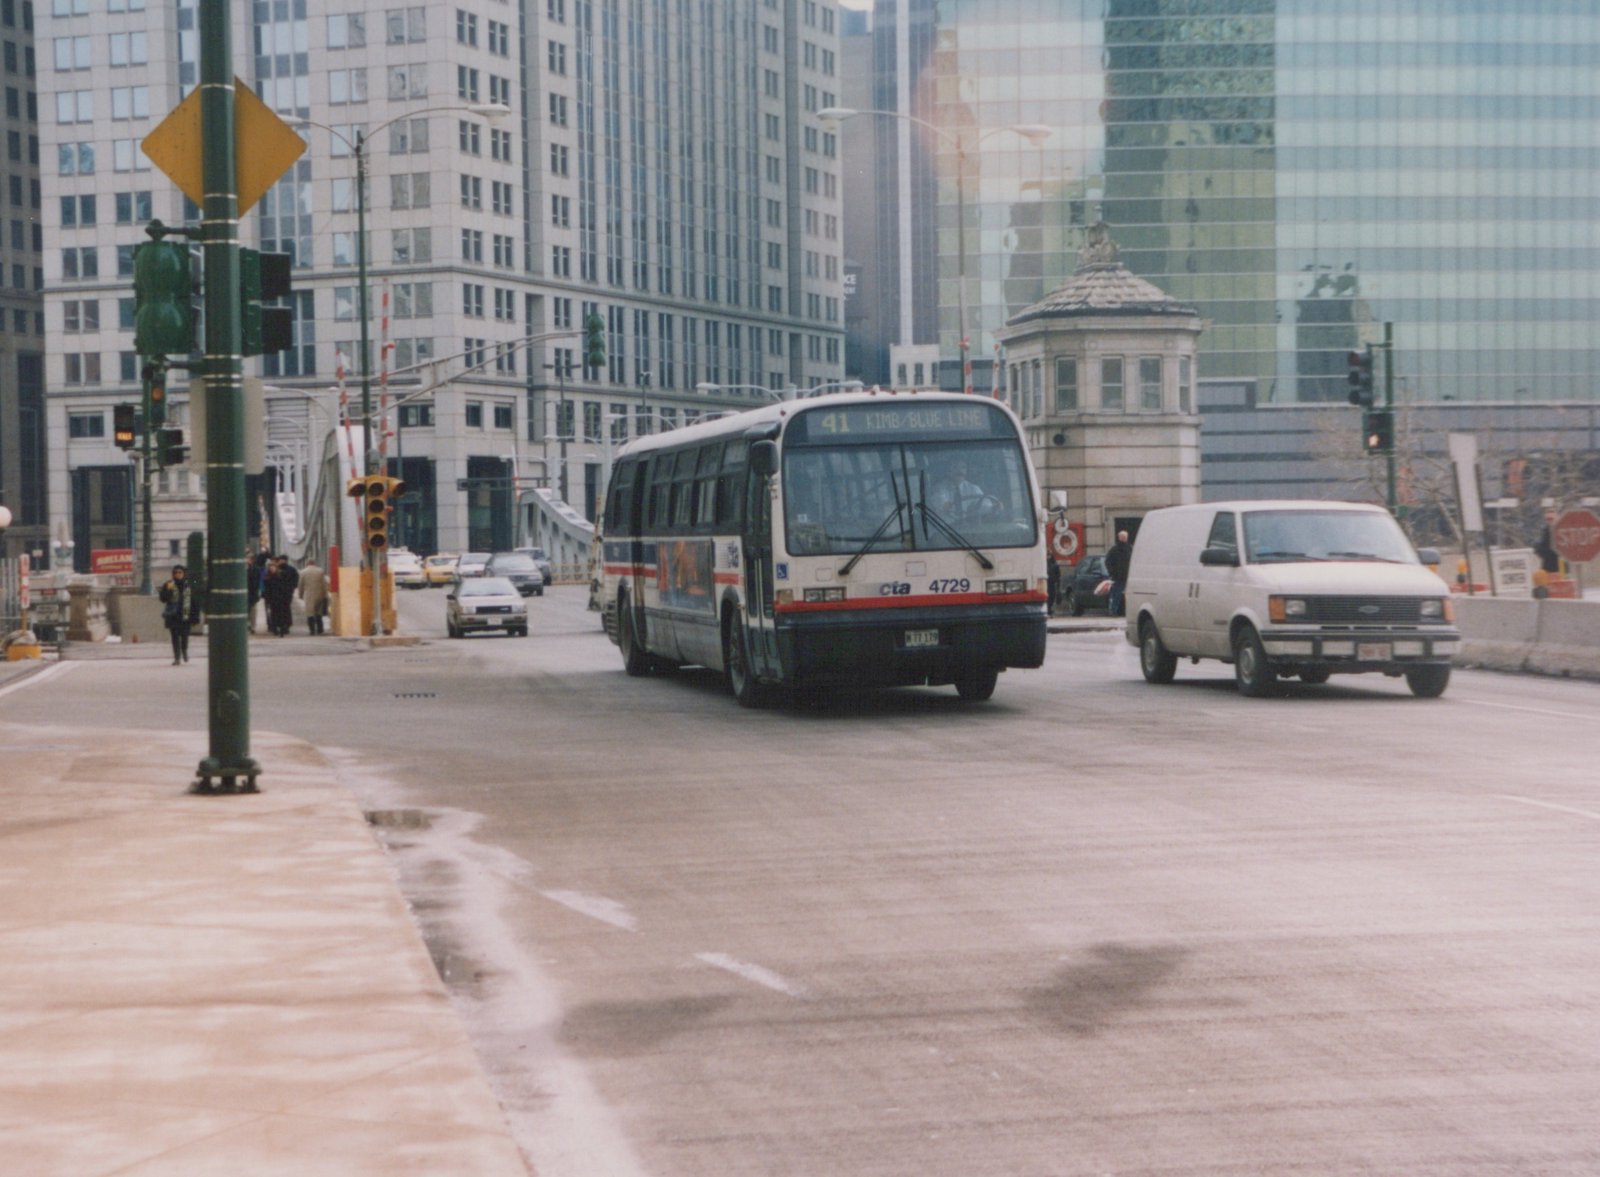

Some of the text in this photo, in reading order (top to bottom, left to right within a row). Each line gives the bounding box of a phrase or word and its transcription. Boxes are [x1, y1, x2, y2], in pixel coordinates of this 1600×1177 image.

[821, 408, 983, 433] 41 KIMB/BLUE LINE
[1558, 527, 1600, 546] STOP
[880, 581, 911, 596] cta
[929, 578, 970, 593] 4729
